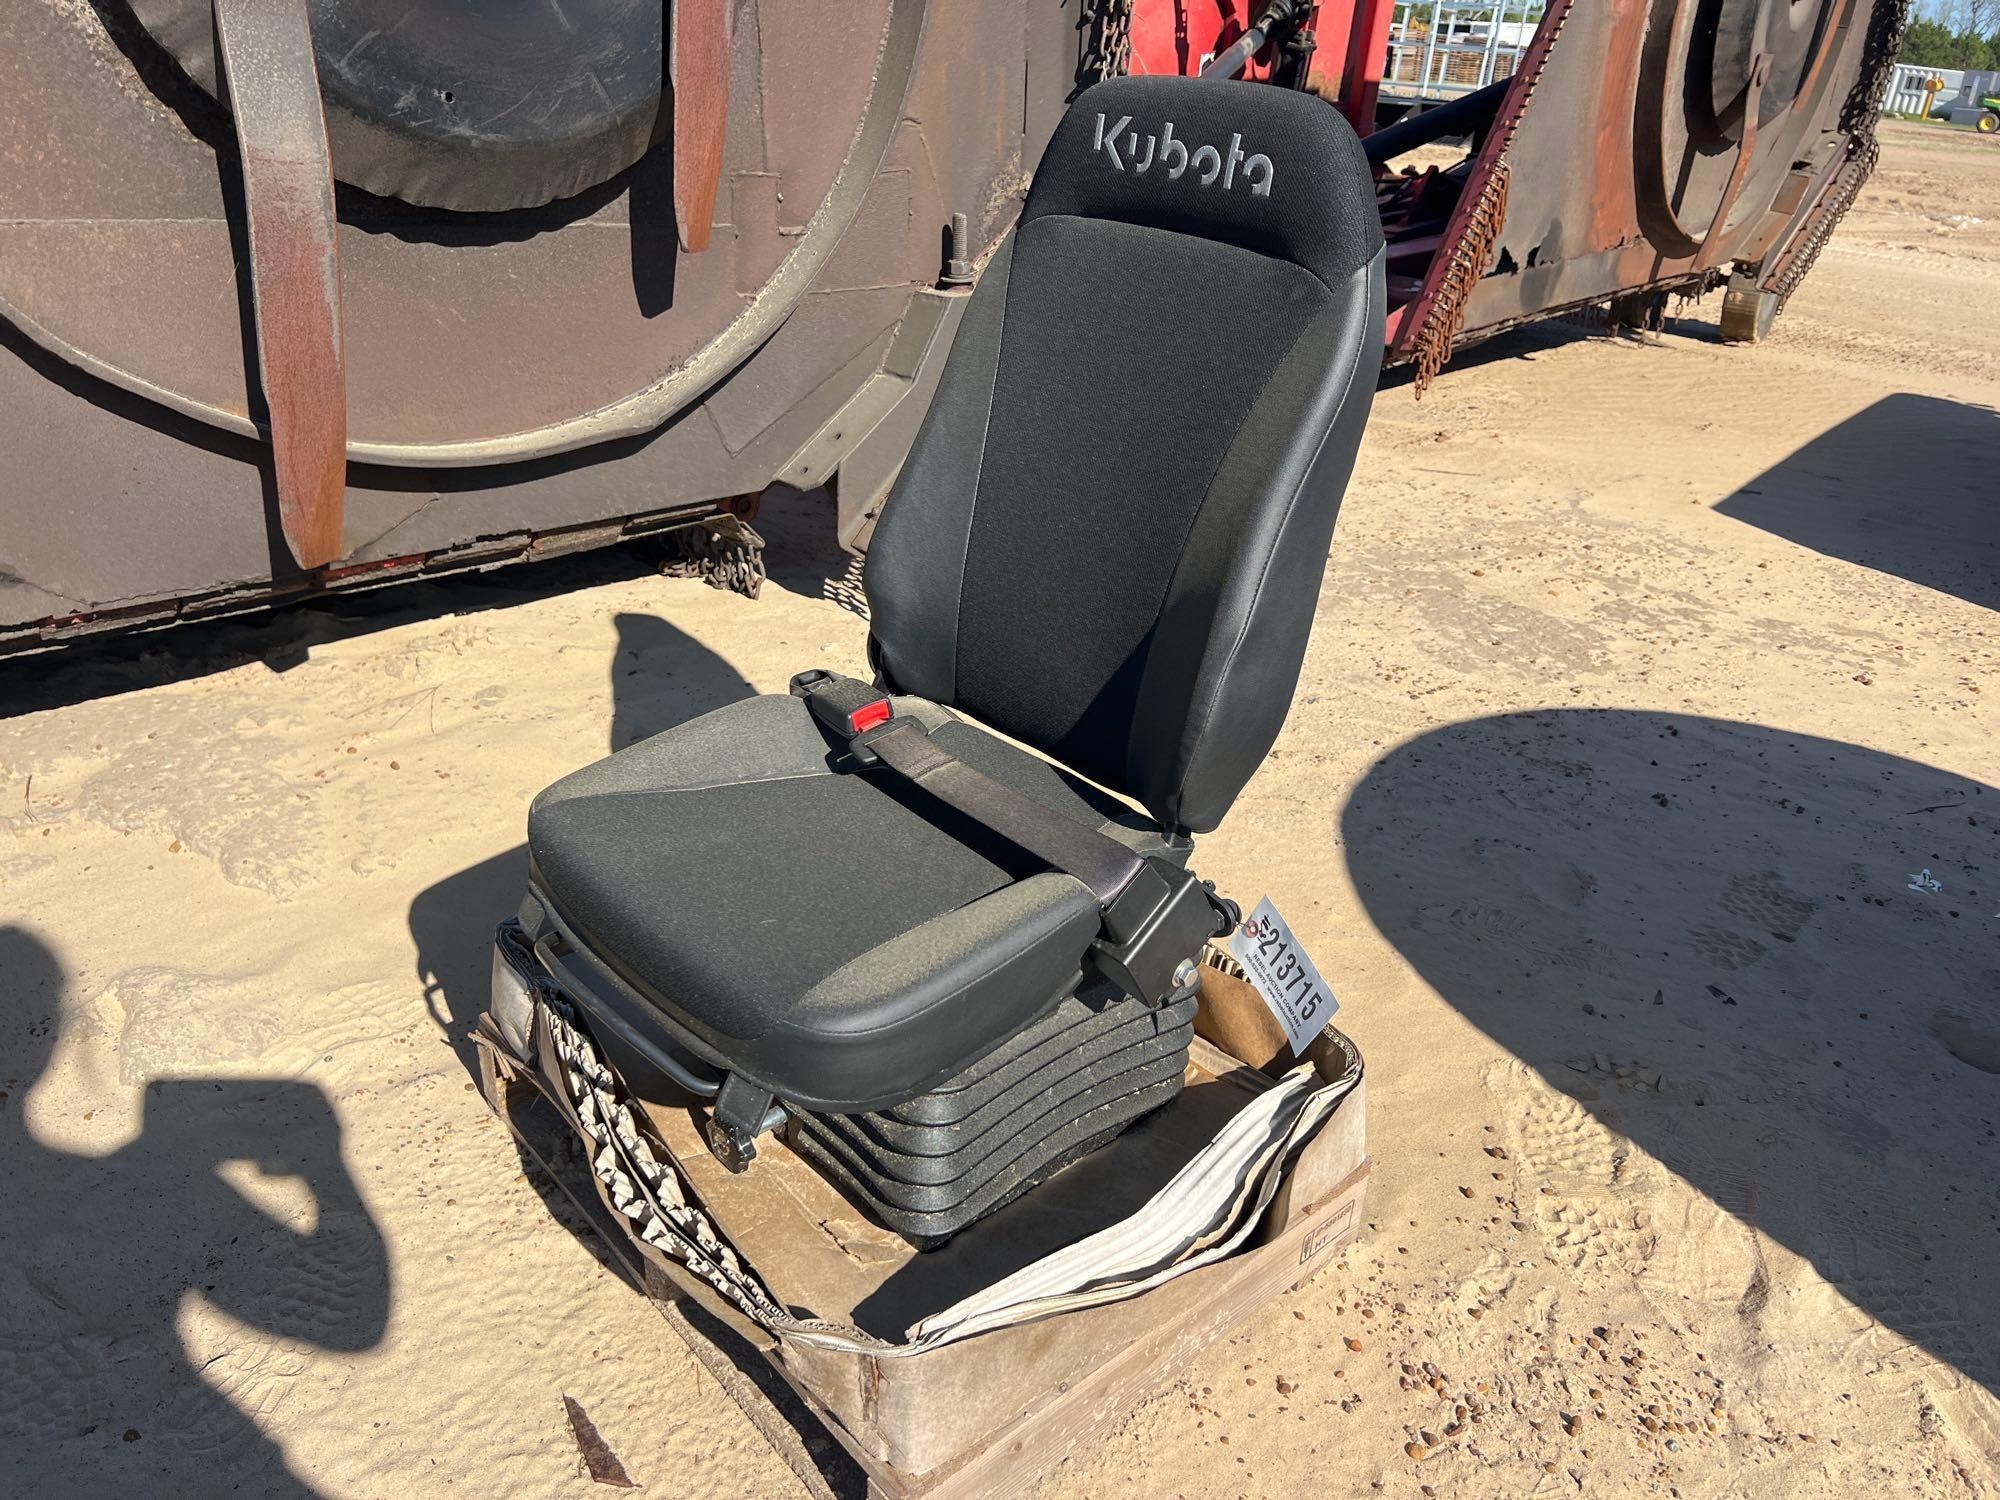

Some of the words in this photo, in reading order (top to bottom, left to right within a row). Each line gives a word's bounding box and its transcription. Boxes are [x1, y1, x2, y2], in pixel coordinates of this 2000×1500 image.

[1093, 113, 1274, 197] Kubota
[1253, 953, 1267, 975] REBEL
[1265, 973, 1284, 1000] AUCTION
[1282, 997, 1301, 1028] COMPANY
[1258, 928, 1322, 1021] 213715
